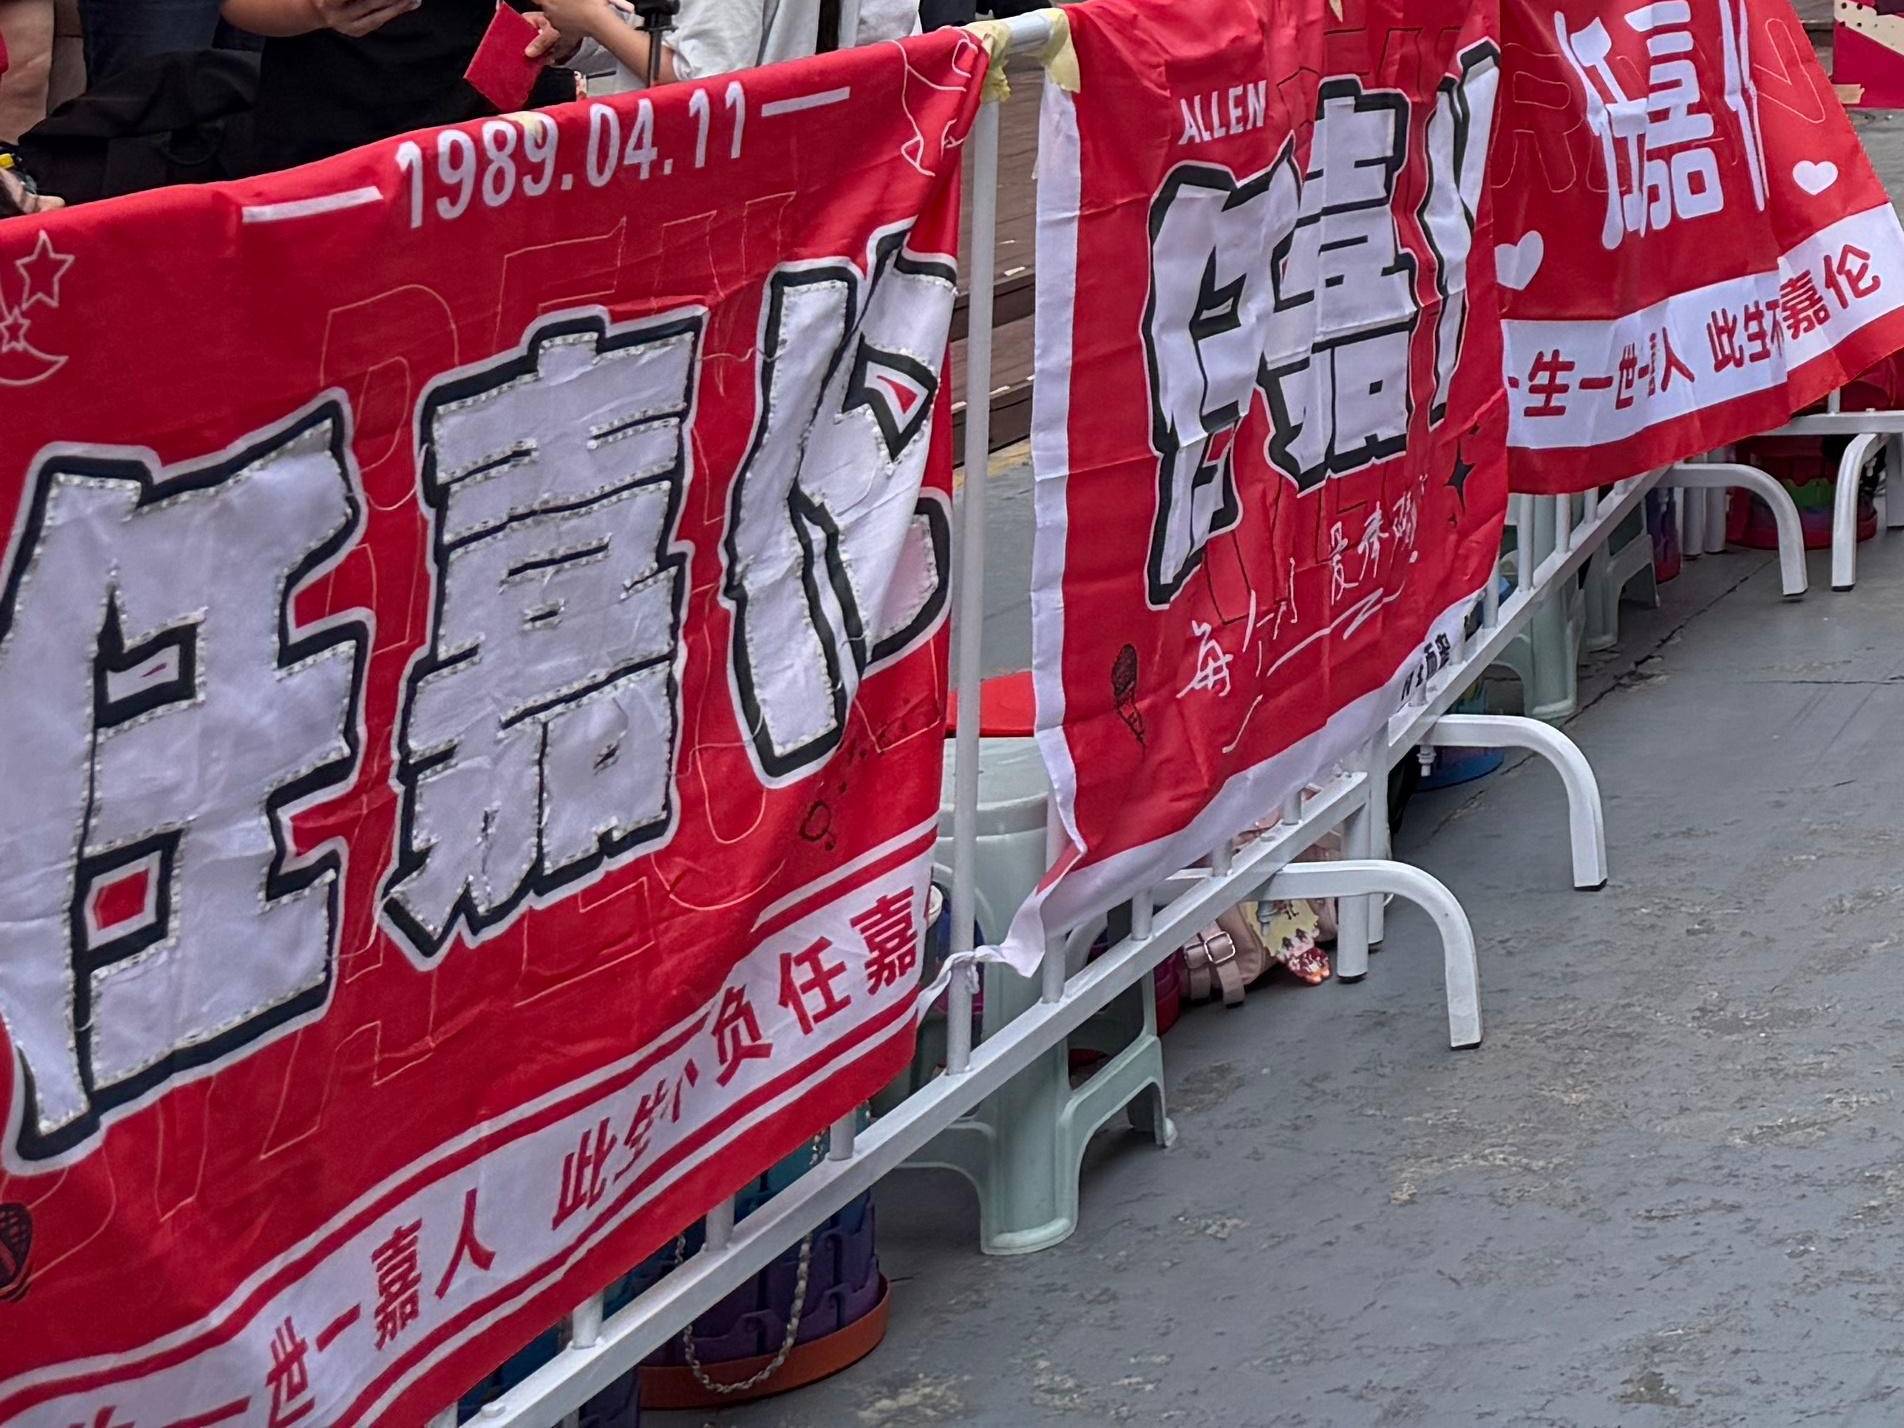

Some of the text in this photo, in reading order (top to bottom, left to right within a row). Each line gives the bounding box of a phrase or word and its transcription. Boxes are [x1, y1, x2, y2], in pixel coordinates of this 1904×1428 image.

[395, 80, 746, 231] 1989.04.11
[1177, 79, 1268, 145] ALLEN
[70, 1187, 498, 1428] 一世一嘉人
